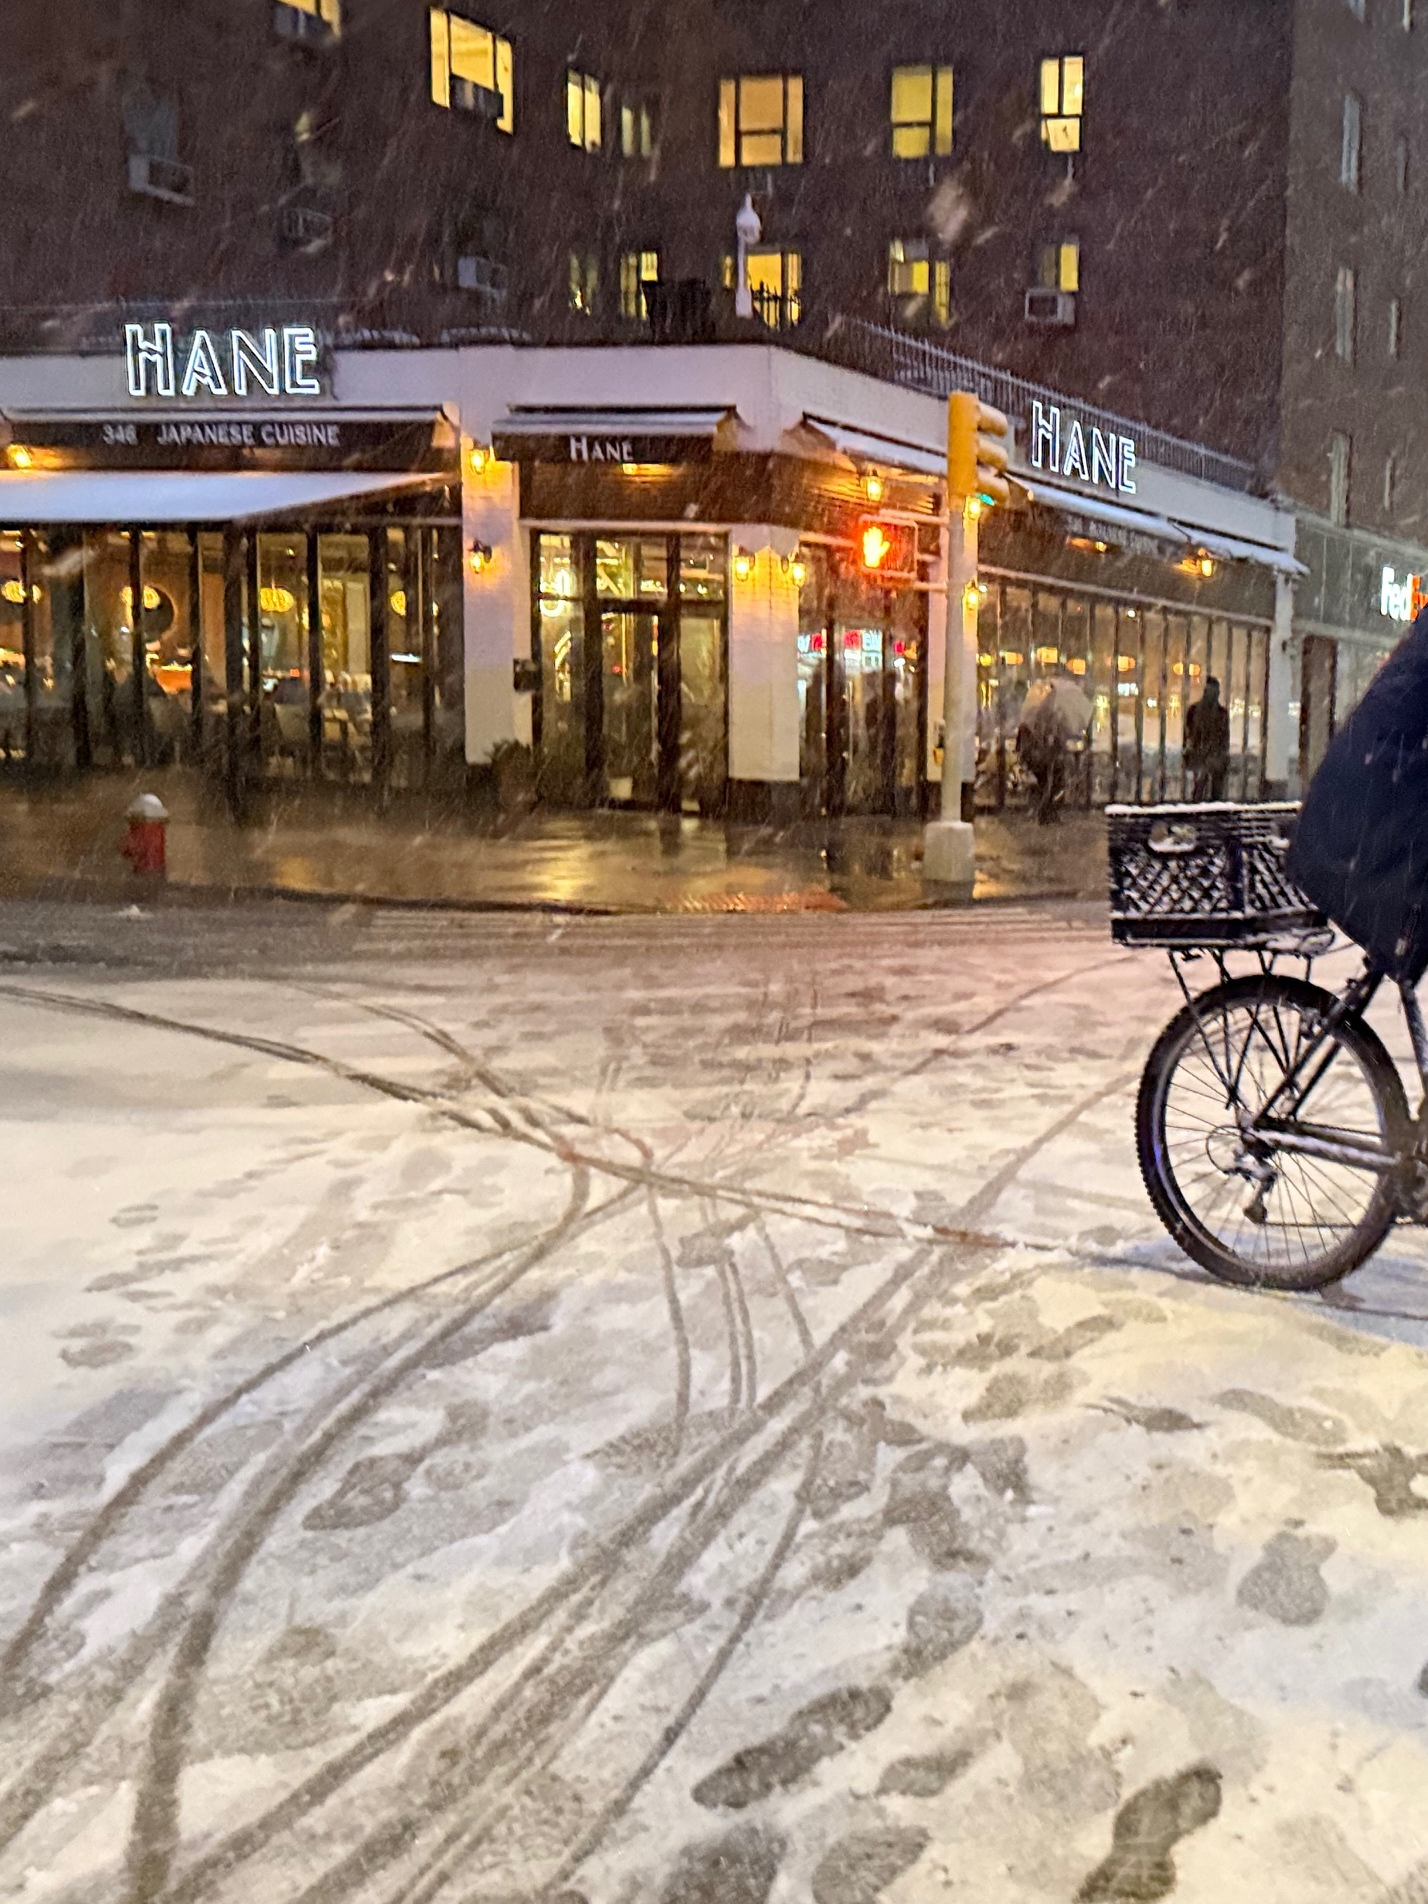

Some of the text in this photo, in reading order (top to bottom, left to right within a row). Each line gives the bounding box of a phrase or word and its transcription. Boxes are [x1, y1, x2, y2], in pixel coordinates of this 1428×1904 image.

[124, 322, 321, 397] HANE
[156, 423, 255, 446] JAPANESE
[260, 424, 341, 447] CUISINE
[569, 434, 634, 462] HANE
[1031, 400, 1137, 494] HANE
